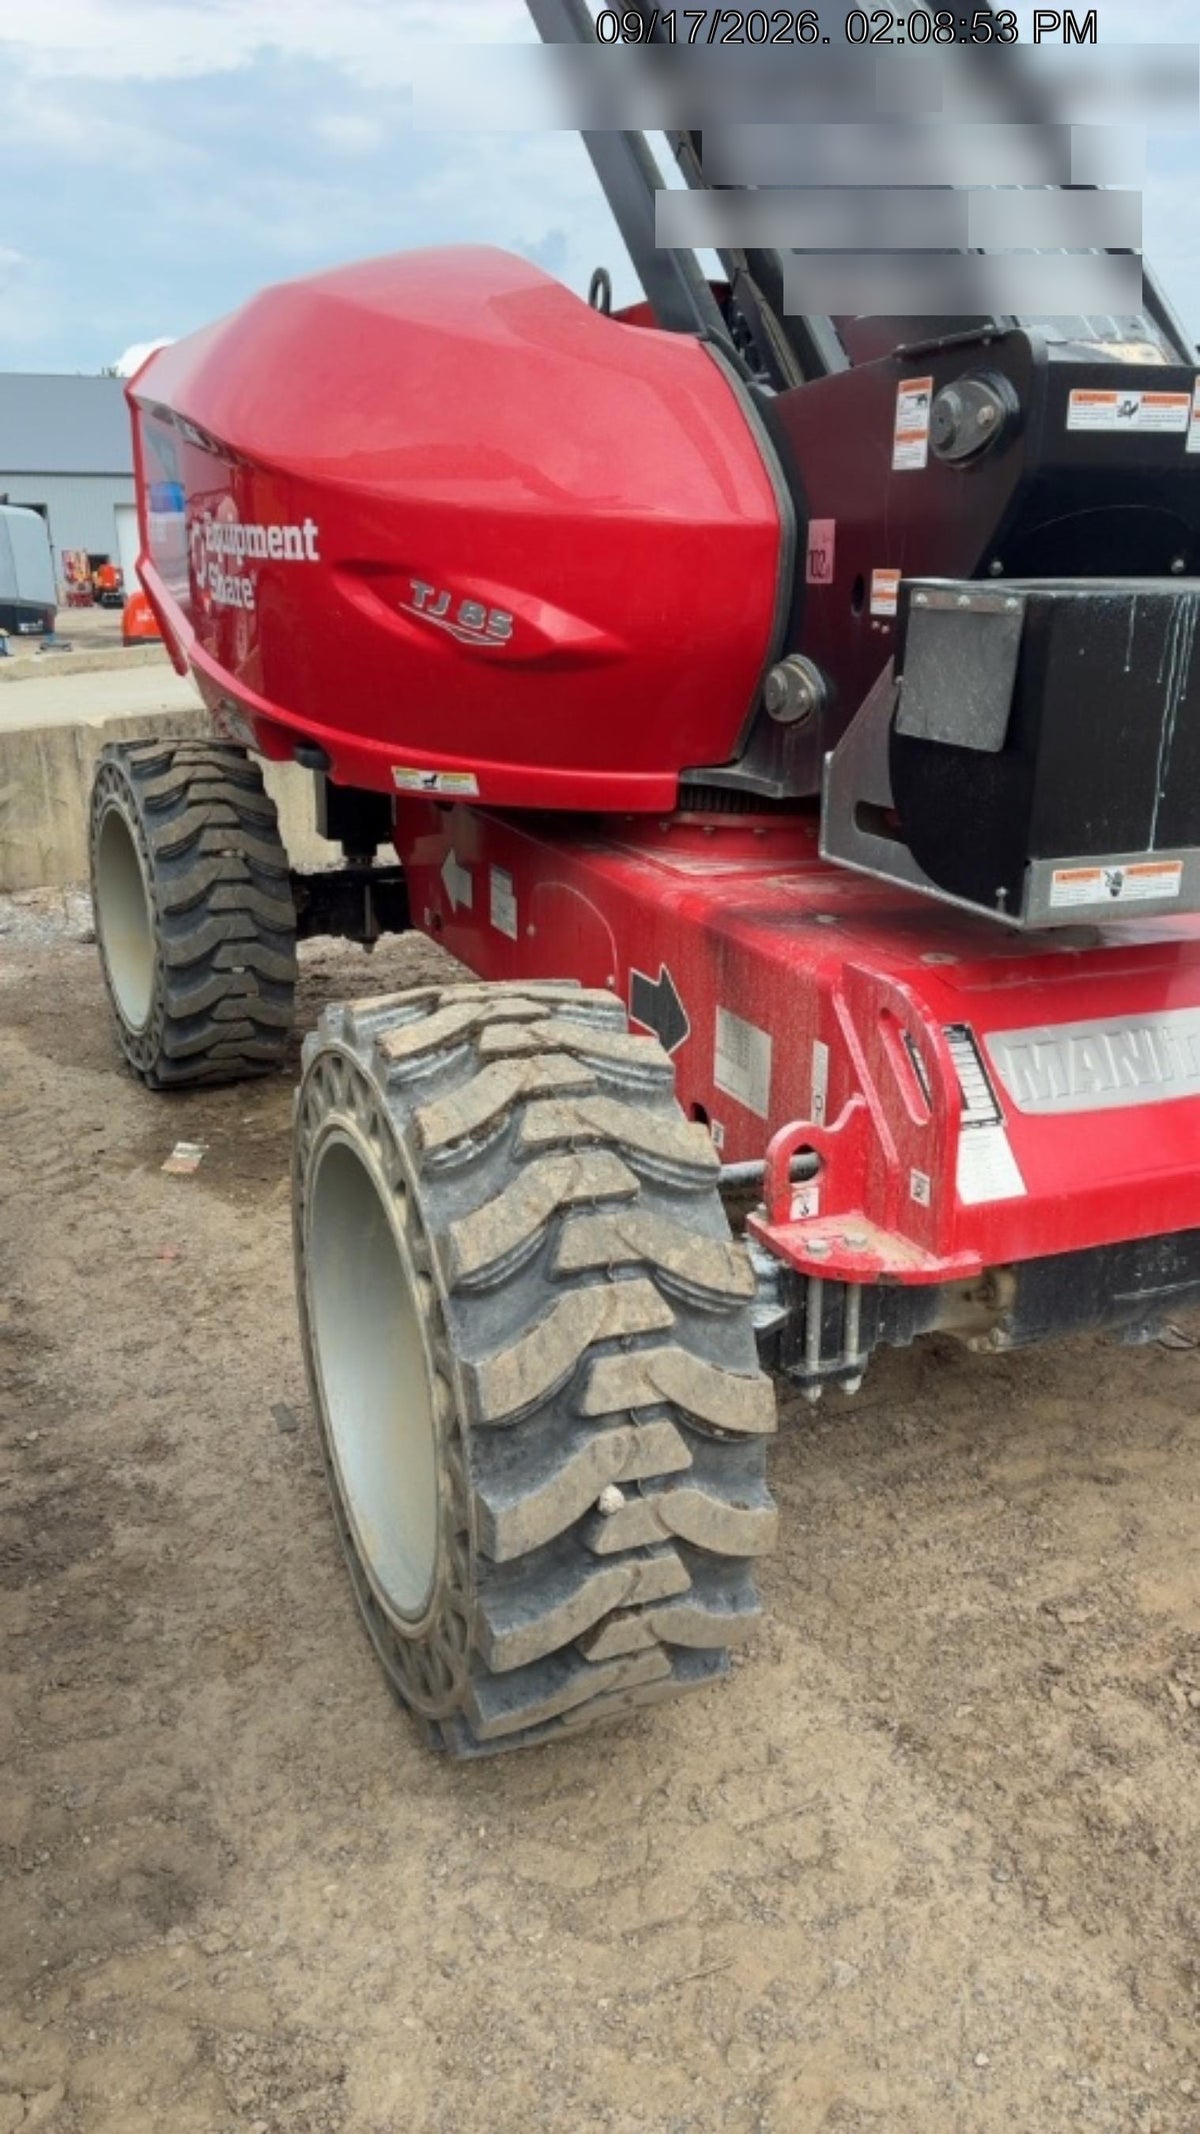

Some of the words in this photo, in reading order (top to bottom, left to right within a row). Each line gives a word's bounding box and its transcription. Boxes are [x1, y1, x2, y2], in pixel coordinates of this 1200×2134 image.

[205, 513, 320, 566] Equipment
[208, 562, 256, 610] Share
[410, 579, 451, 616] TJ
[458, 599, 514, 640] 85
